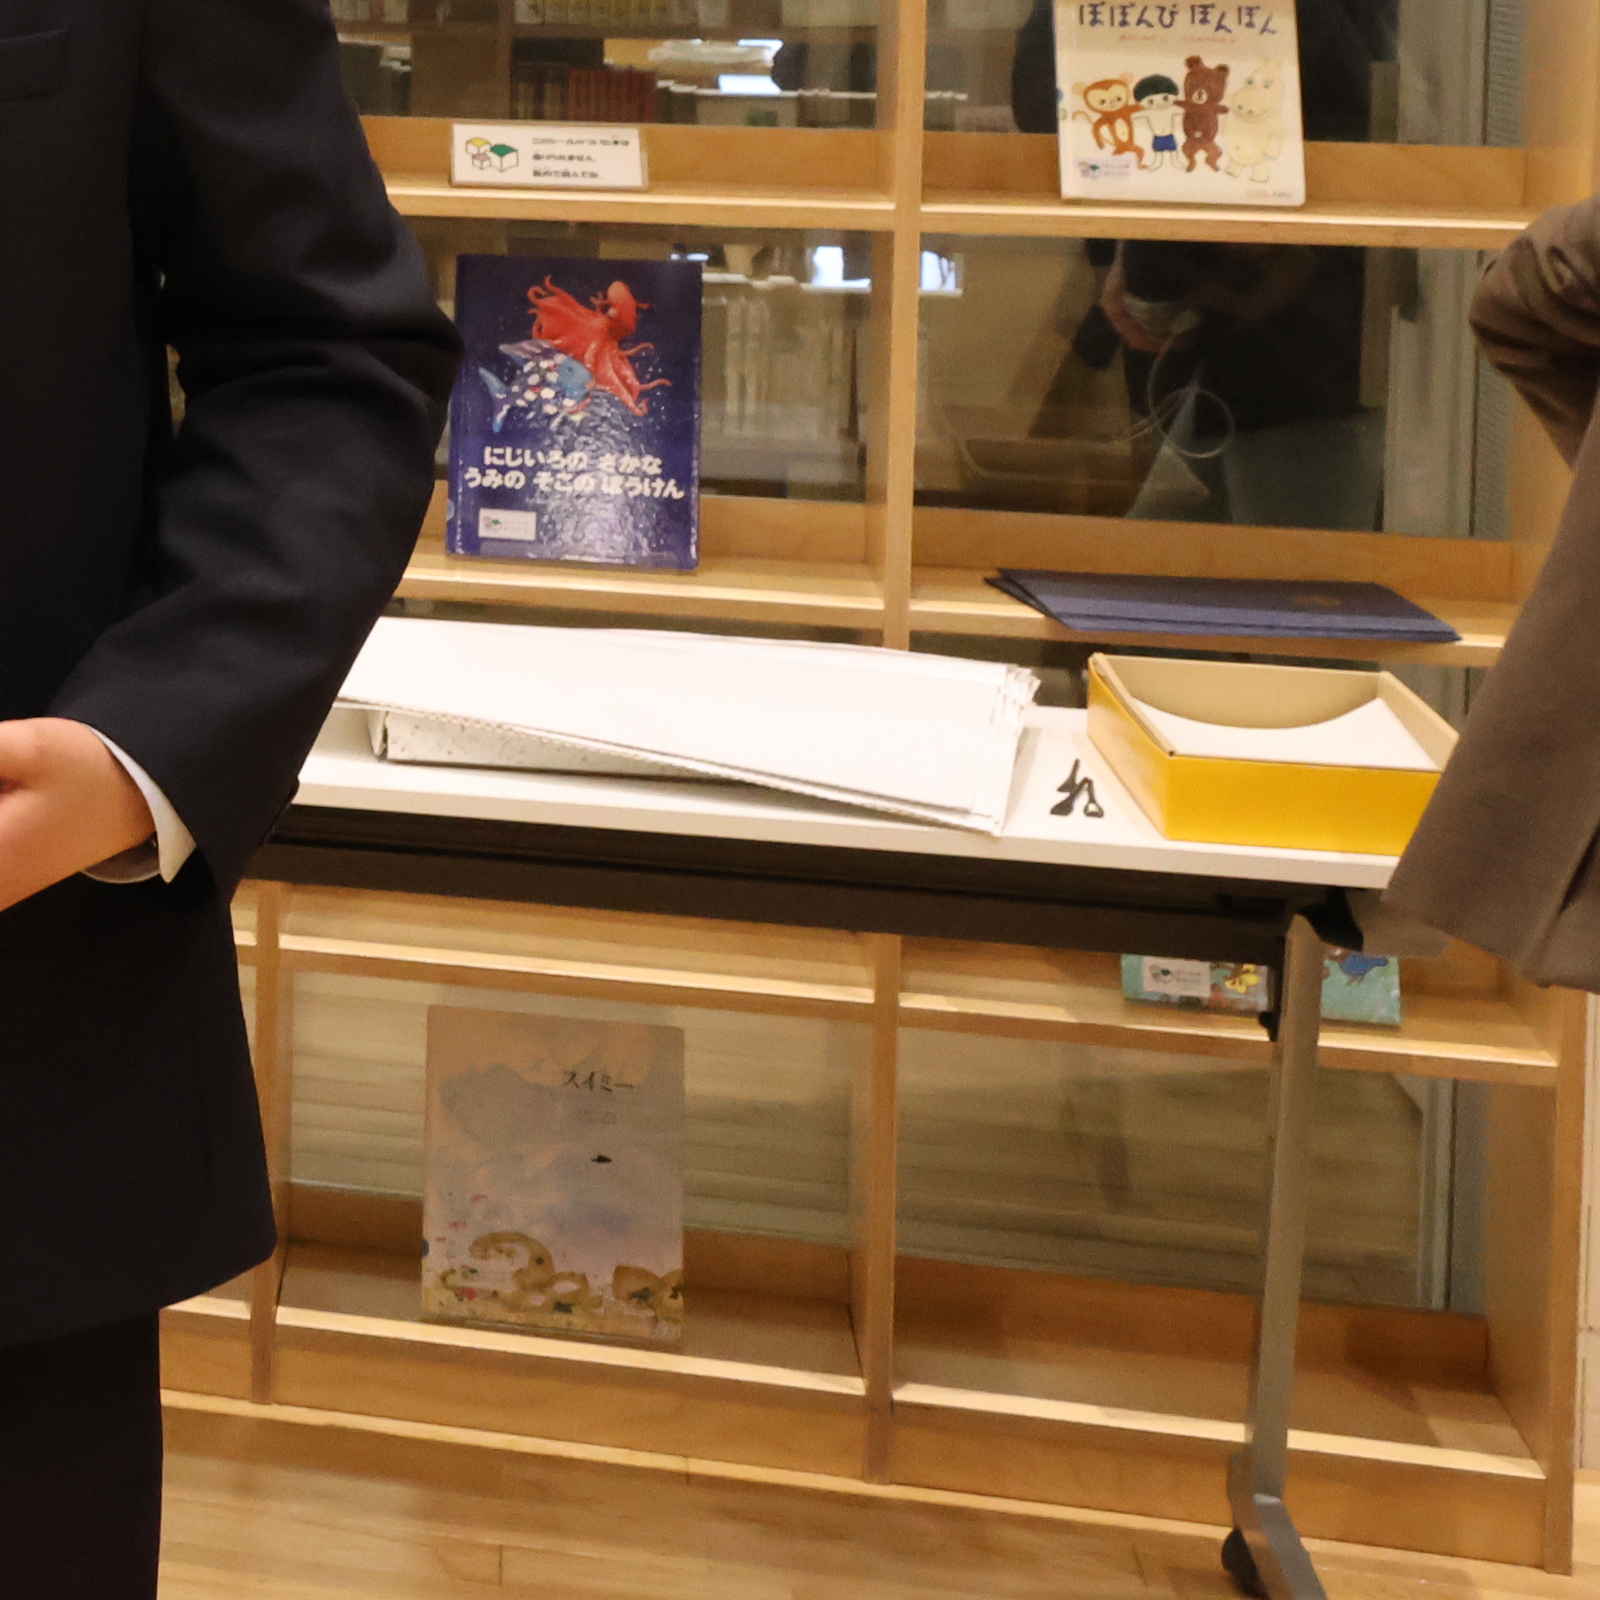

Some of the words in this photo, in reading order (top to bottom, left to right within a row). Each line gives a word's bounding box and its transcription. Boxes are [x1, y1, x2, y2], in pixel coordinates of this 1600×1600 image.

[483, 445, 588, 471] にじいろの
[599, 451, 663, 476] さかな
[464, 466, 527, 490] うみの
[532, 470, 597, 494] そこの
[561, 1070, 636, 1094] スイミー
